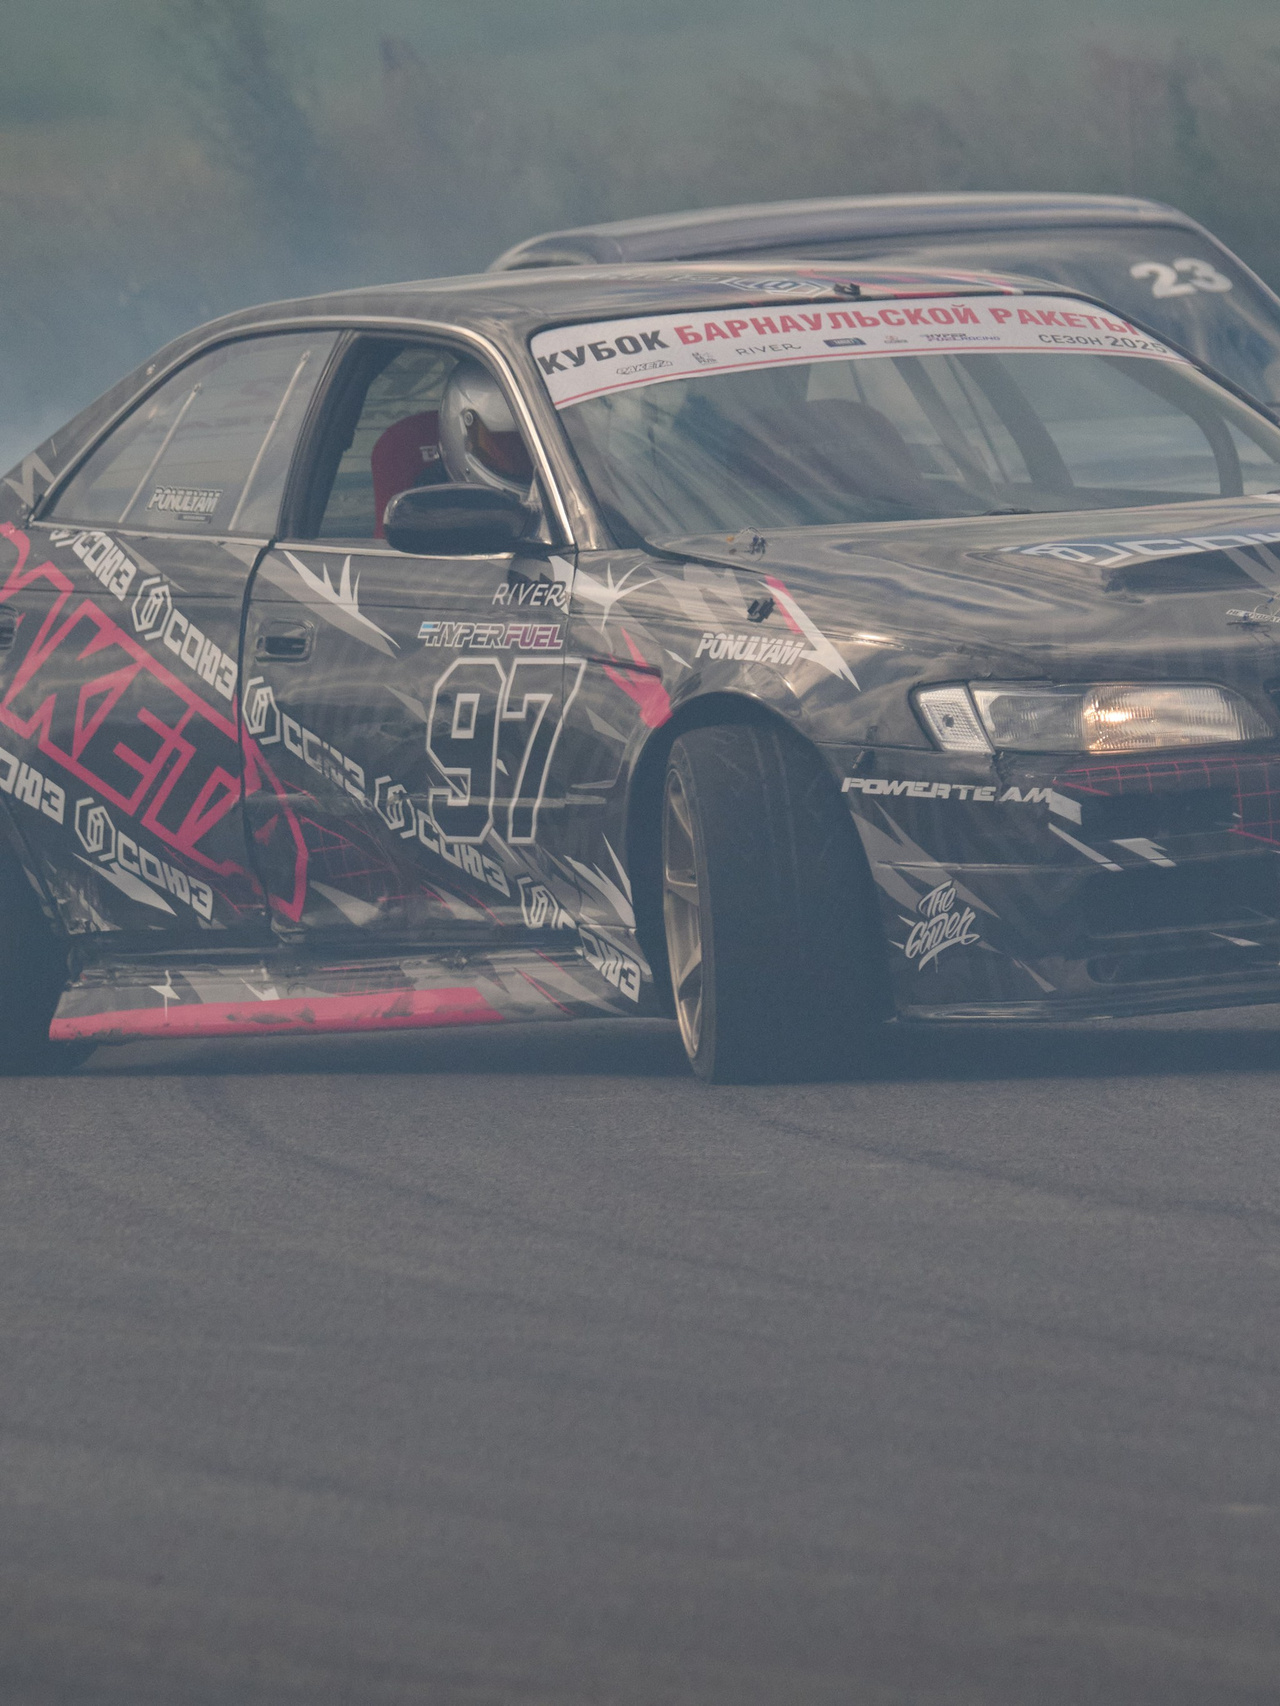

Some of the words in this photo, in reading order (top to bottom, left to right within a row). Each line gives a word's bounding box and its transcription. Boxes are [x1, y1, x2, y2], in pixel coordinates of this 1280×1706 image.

[1129, 257, 1234, 298] 23
[537, 329, 670, 375] КУБОК
[673, 304, 980, 345] БАРНАУЛЬСКОЙ
[988, 307, 1140, 336] РАКЕТЫ
[735, 342, 803, 357] RIVER
[1038, 333, 1103, 346] СЕЗОН
[1104, 335, 1168, 354] 2025
[492, 583, 569, 607] RIVER
[163, 608, 239, 701] СОЮЗ
[694, 632, 805, 666] PONULYAM
[426, 656, 588, 845] 97
[117, 830, 214, 921] СОЮЗ
